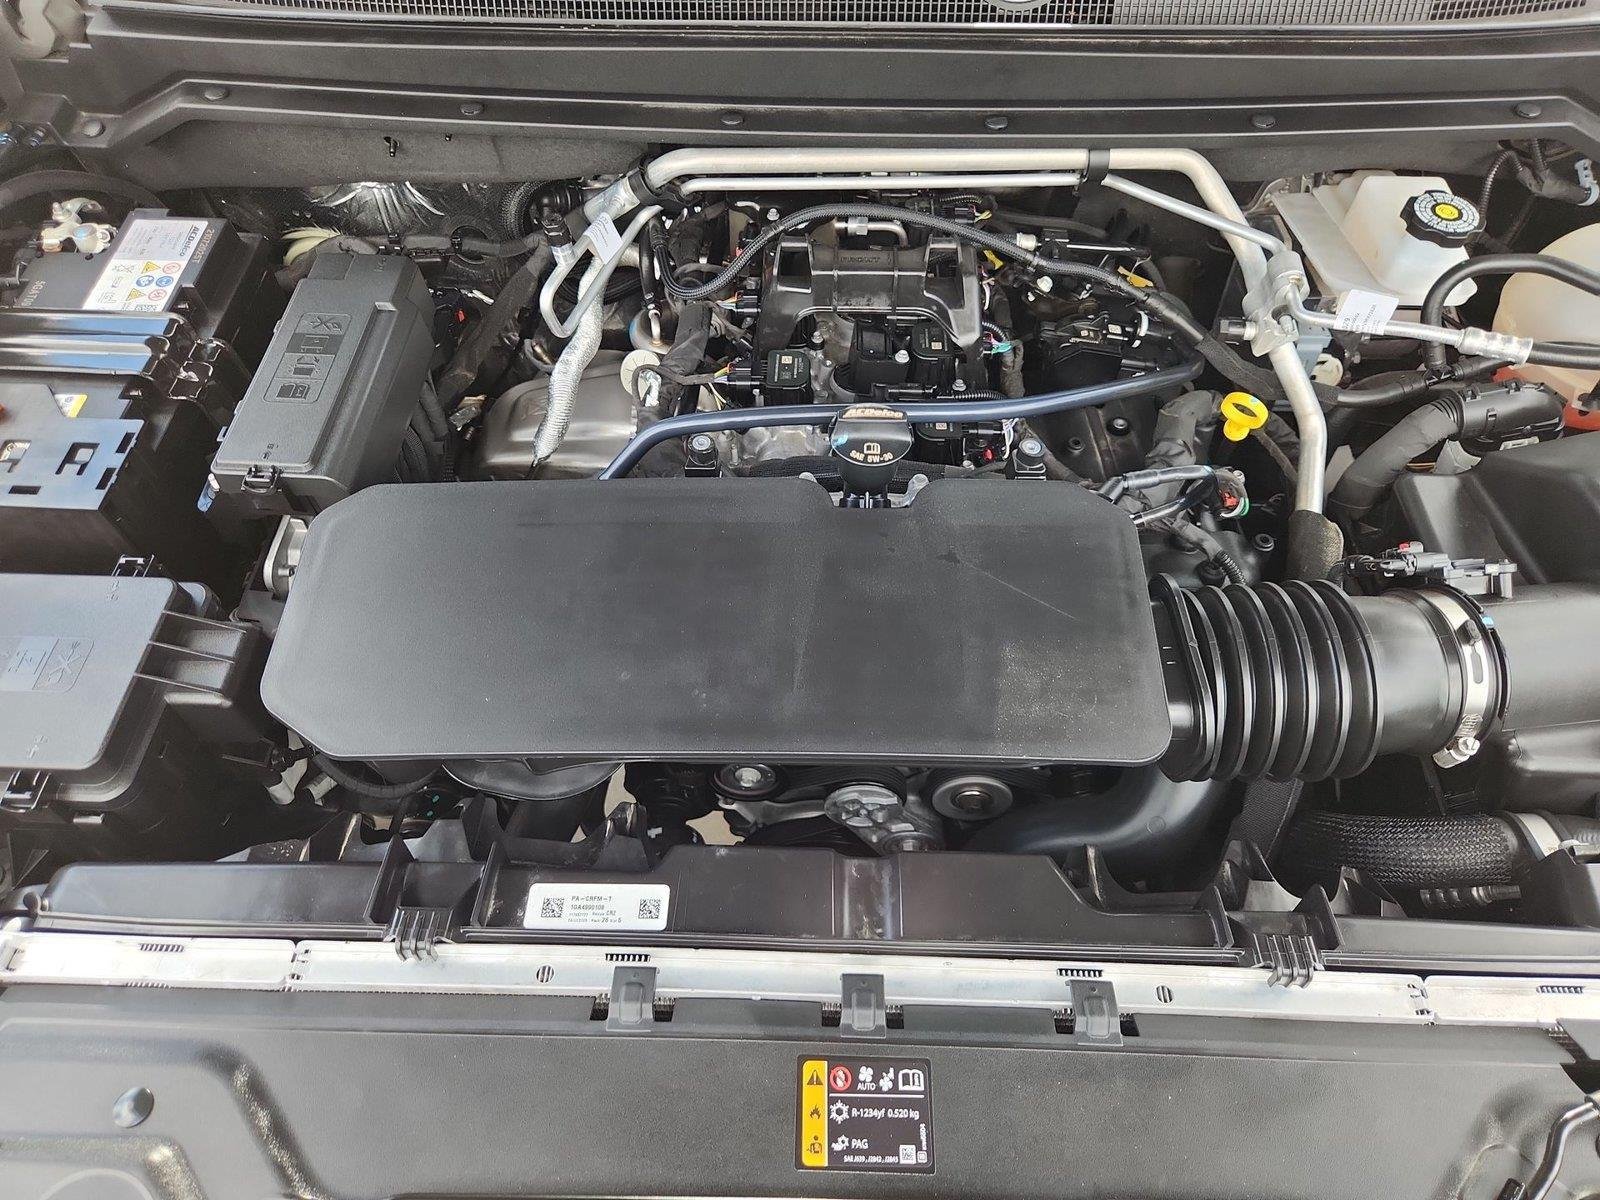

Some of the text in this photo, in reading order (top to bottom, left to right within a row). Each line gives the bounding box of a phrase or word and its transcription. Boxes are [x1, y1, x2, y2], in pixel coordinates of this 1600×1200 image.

[850, 450, 894, 463] SAE 5W-30
[857, 1082, 876, 1091] AUTO
[851, 1107, 920, 1120] R-1234yf 0.520 kg
[851, 1139, 869, 1149] PAG
